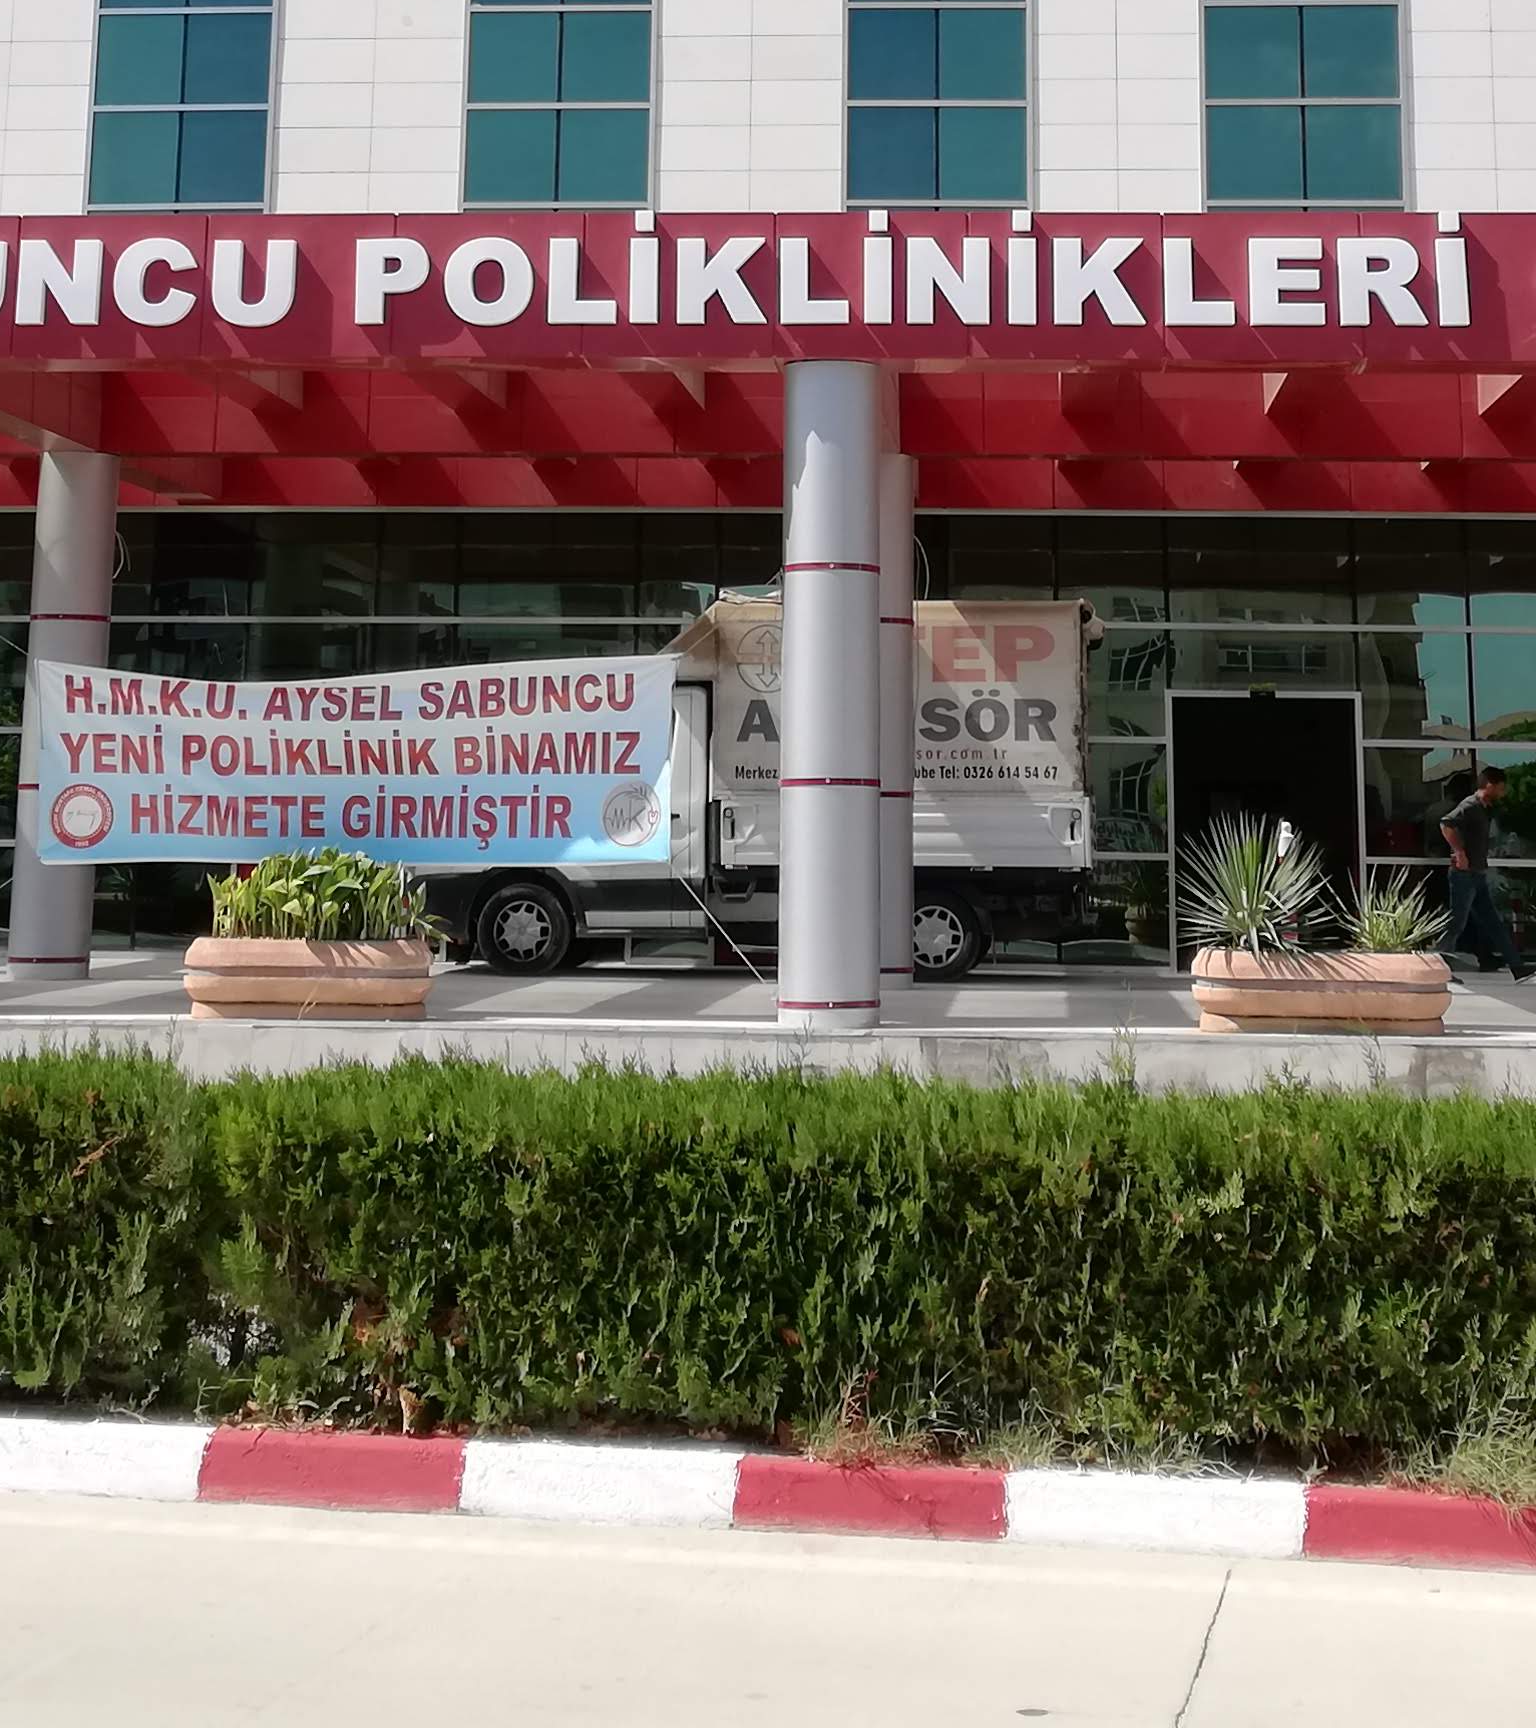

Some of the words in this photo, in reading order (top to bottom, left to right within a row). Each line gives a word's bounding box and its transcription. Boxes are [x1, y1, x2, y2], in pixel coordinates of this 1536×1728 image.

[354, 210, 1470, 327] POLİKLİNİKLERİ
[262, 684, 403, 722] AYSEL
[418, 673, 635, 721] SABUNCU
[59, 724, 164, 774] YENİ
[182, 728, 440, 776] POLİKLİNİK
[453, 726, 641, 775] BİNAMIZ
[735, 765, 778, 780] Merkez
[939, 766, 960, 780] Tel:
[963, 766, 994, 780] 0326
[998, 766, 1021, 780] 614
[1024, 766, 1040, 780] 54
[1043, 766, 1059, 780] 67
[130, 783, 326, 838] HİZMETE
[341, 785, 574, 851] GİRMİŞTİR
